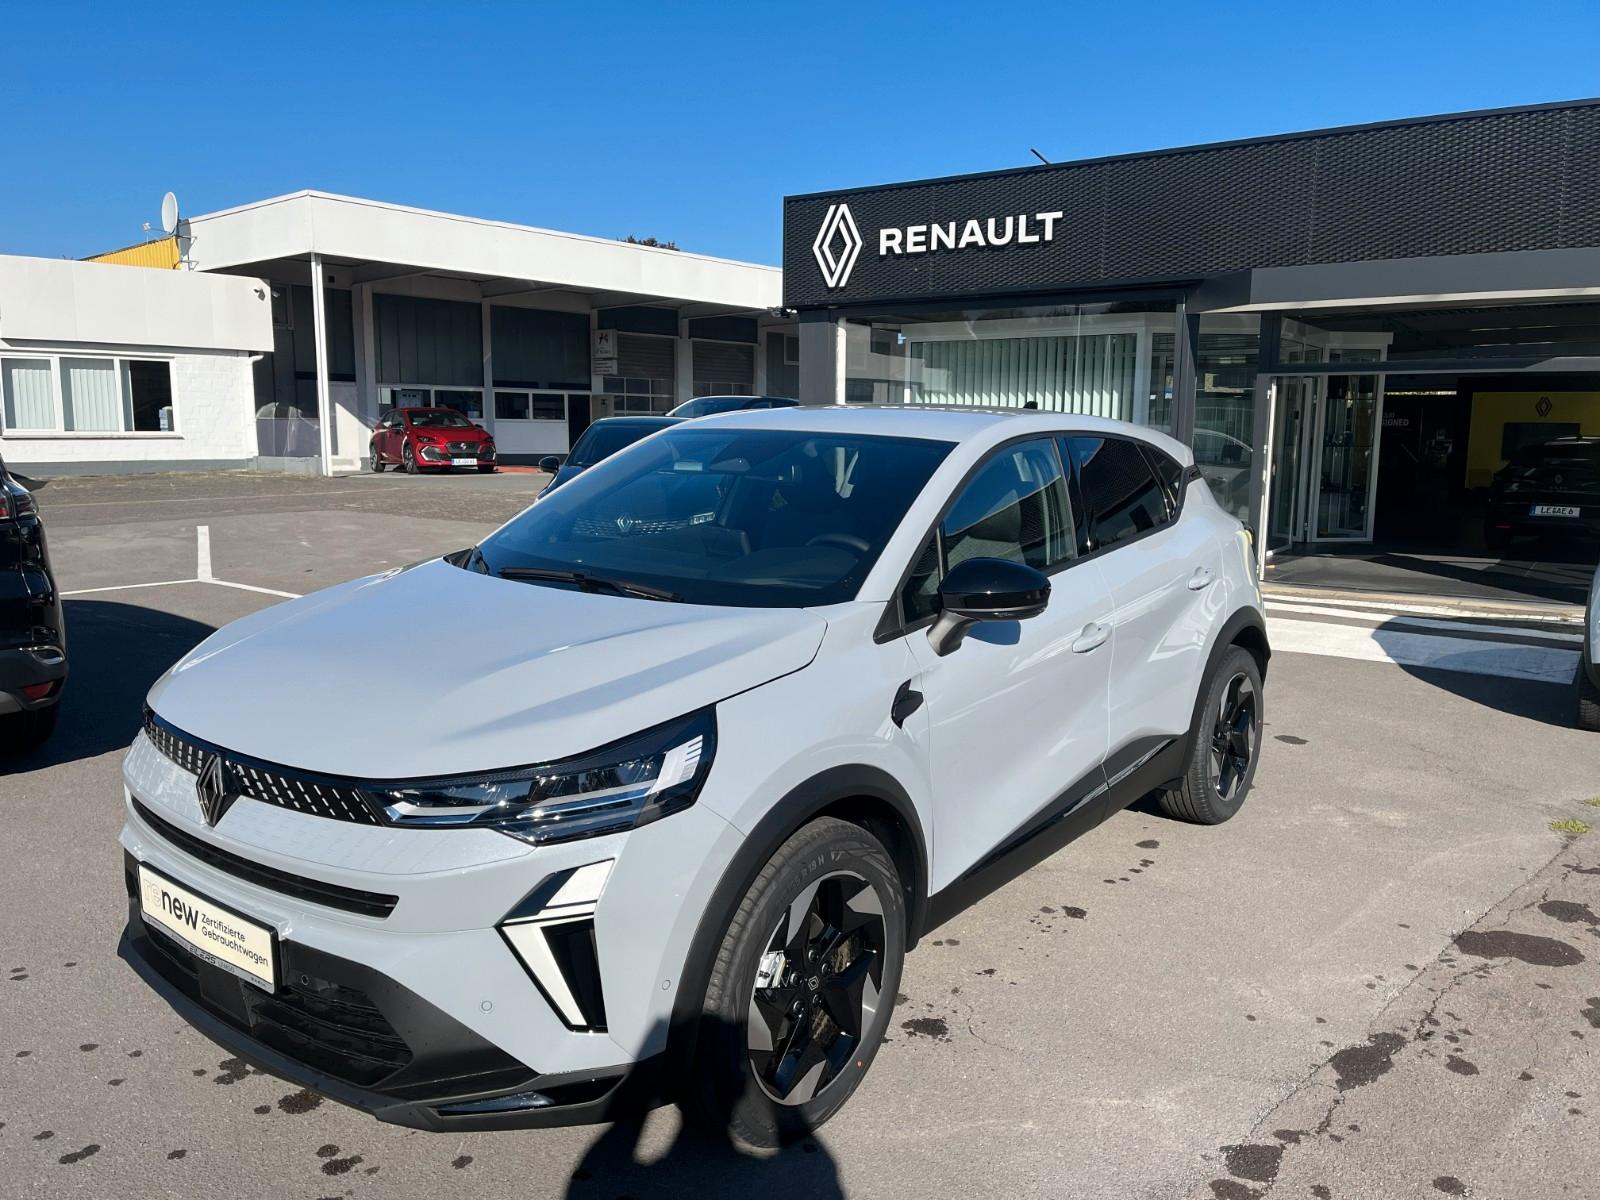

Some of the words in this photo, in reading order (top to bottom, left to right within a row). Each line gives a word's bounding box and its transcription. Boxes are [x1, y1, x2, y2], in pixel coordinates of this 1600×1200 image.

[879, 211, 1064, 256] RENAULT
[201, 913, 246, 943] Zertifizierte
[201, 926, 269, 968] Gebrauchtwagen
